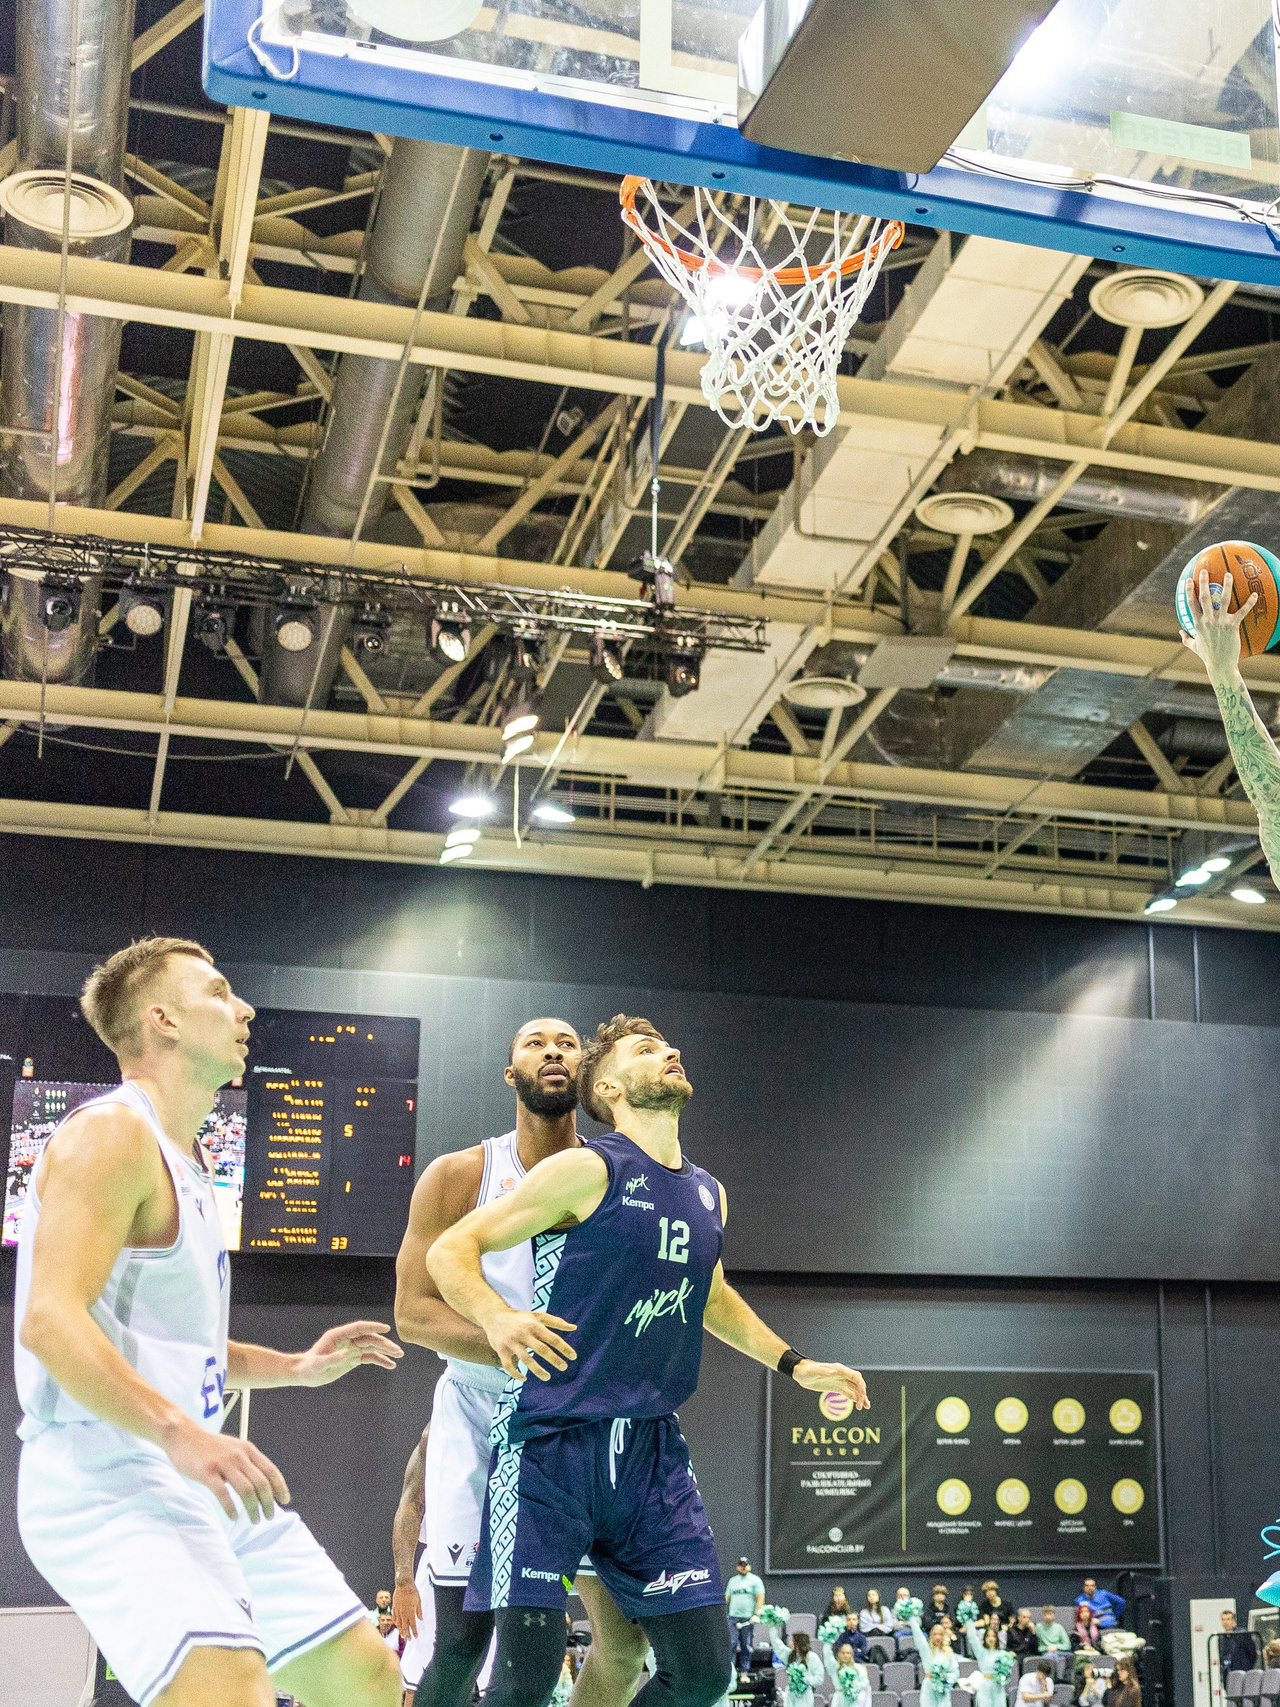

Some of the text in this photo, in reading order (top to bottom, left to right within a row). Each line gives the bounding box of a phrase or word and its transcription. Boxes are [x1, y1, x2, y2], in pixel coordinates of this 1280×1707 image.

[622, 1195, 655, 1211] Kempa
[657, 1216, 691, 1264] 12
[791, 1426, 881, 1445] FALCON
[812, 1447, 860, 1457] CLUB
[521, 1567, 561, 1583] Kempa
